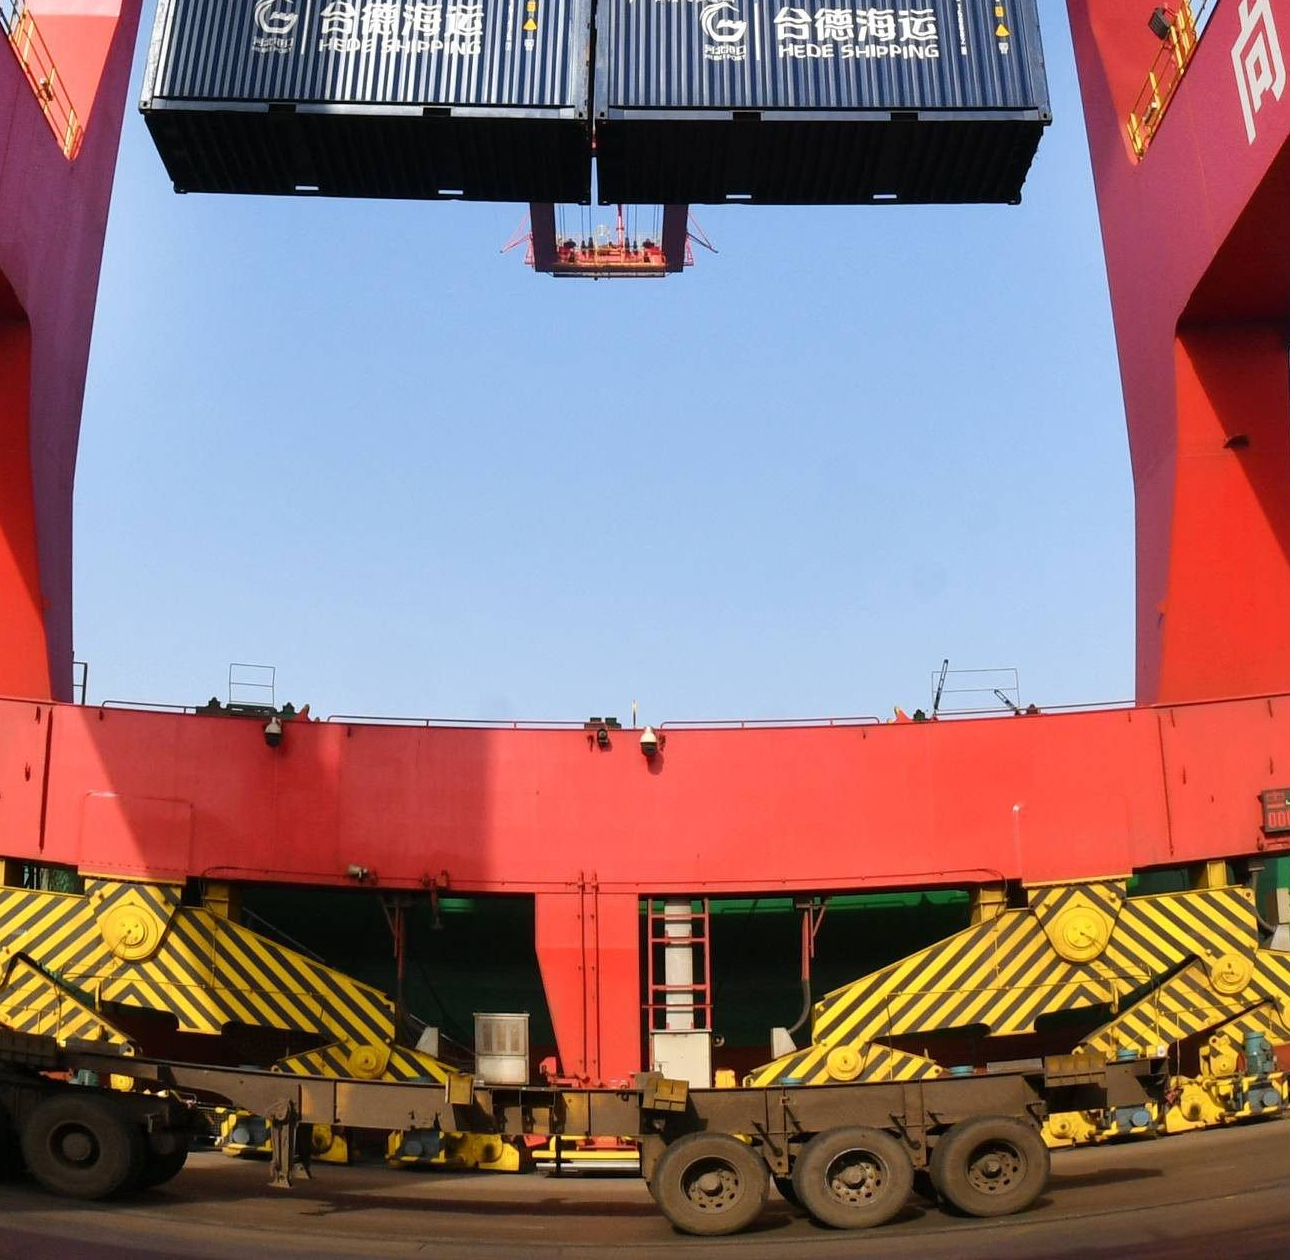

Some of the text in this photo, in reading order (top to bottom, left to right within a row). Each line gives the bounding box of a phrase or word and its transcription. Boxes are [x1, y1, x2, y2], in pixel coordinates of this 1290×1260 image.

[318, 38, 482, 54] HEDE SHIPPING
[778, 43, 940, 59] HEDE SHIPPING
